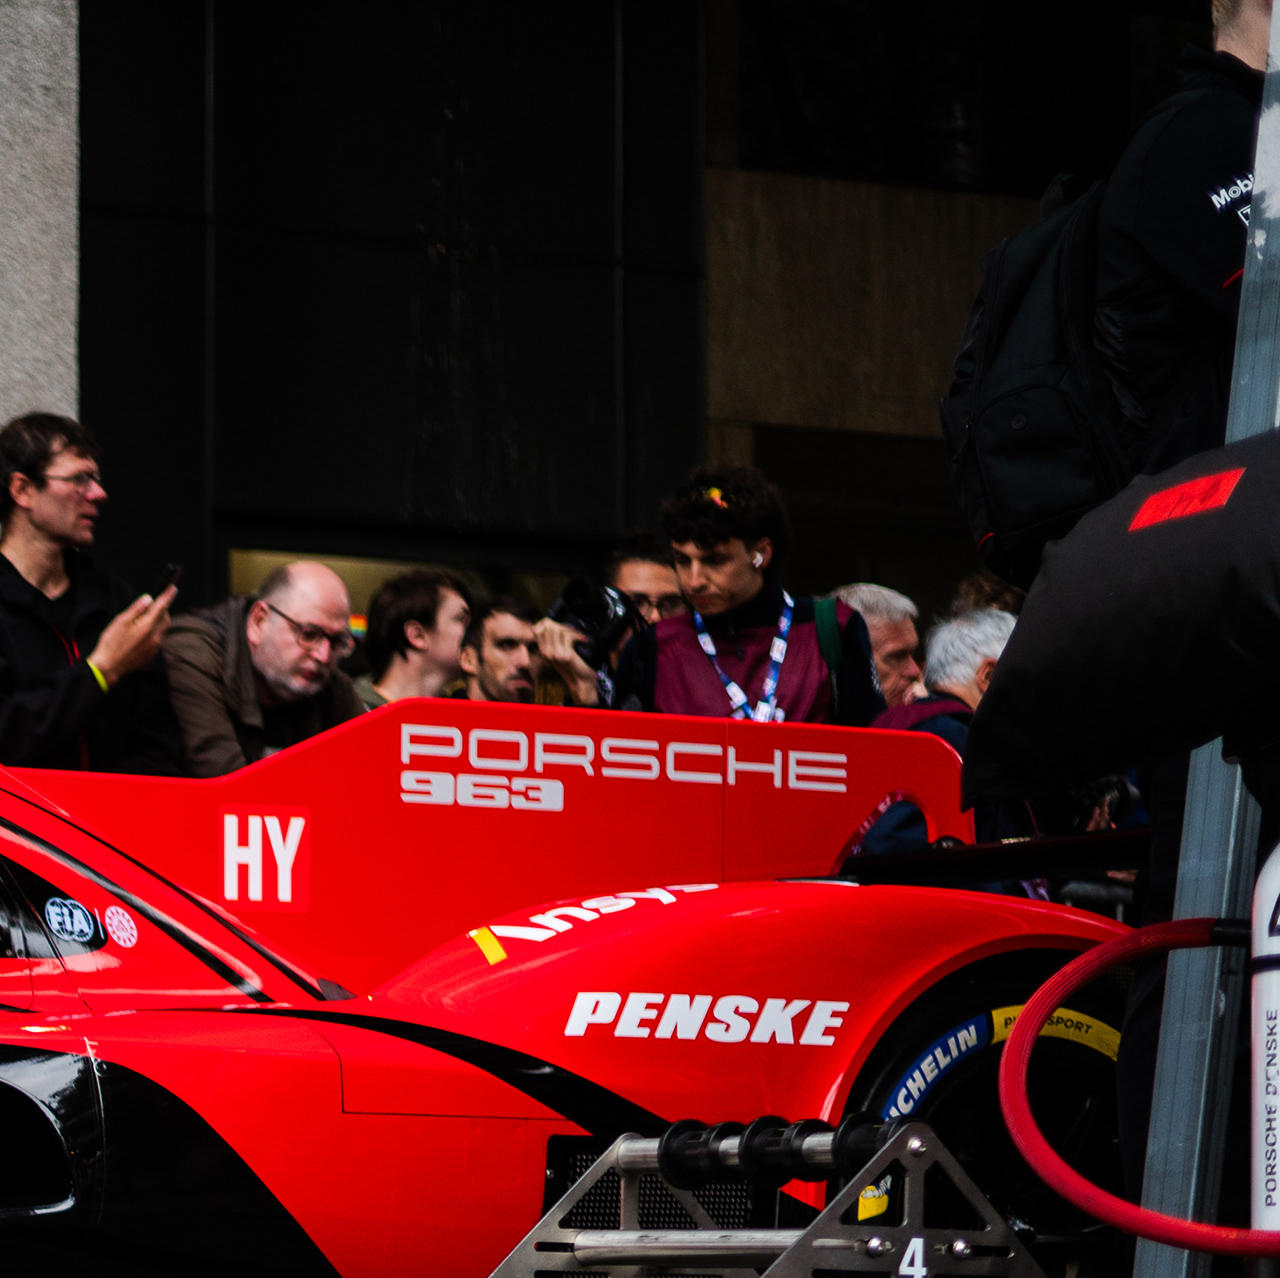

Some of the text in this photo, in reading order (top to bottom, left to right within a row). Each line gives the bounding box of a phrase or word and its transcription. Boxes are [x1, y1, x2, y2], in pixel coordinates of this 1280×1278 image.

[1211, 173, 1254, 209] Mob
[399, 723, 848, 794] PORSCHE
[399, 769, 565, 813] 963
[223, 813, 307, 903] HY
[563, 991, 851, 1047] PENSKE
[1046, 1013, 1095, 1036] SPORT
[885, 1023, 978, 1121] ICHELIN
[1265, 1103, 1278, 1208] PORSCHE
